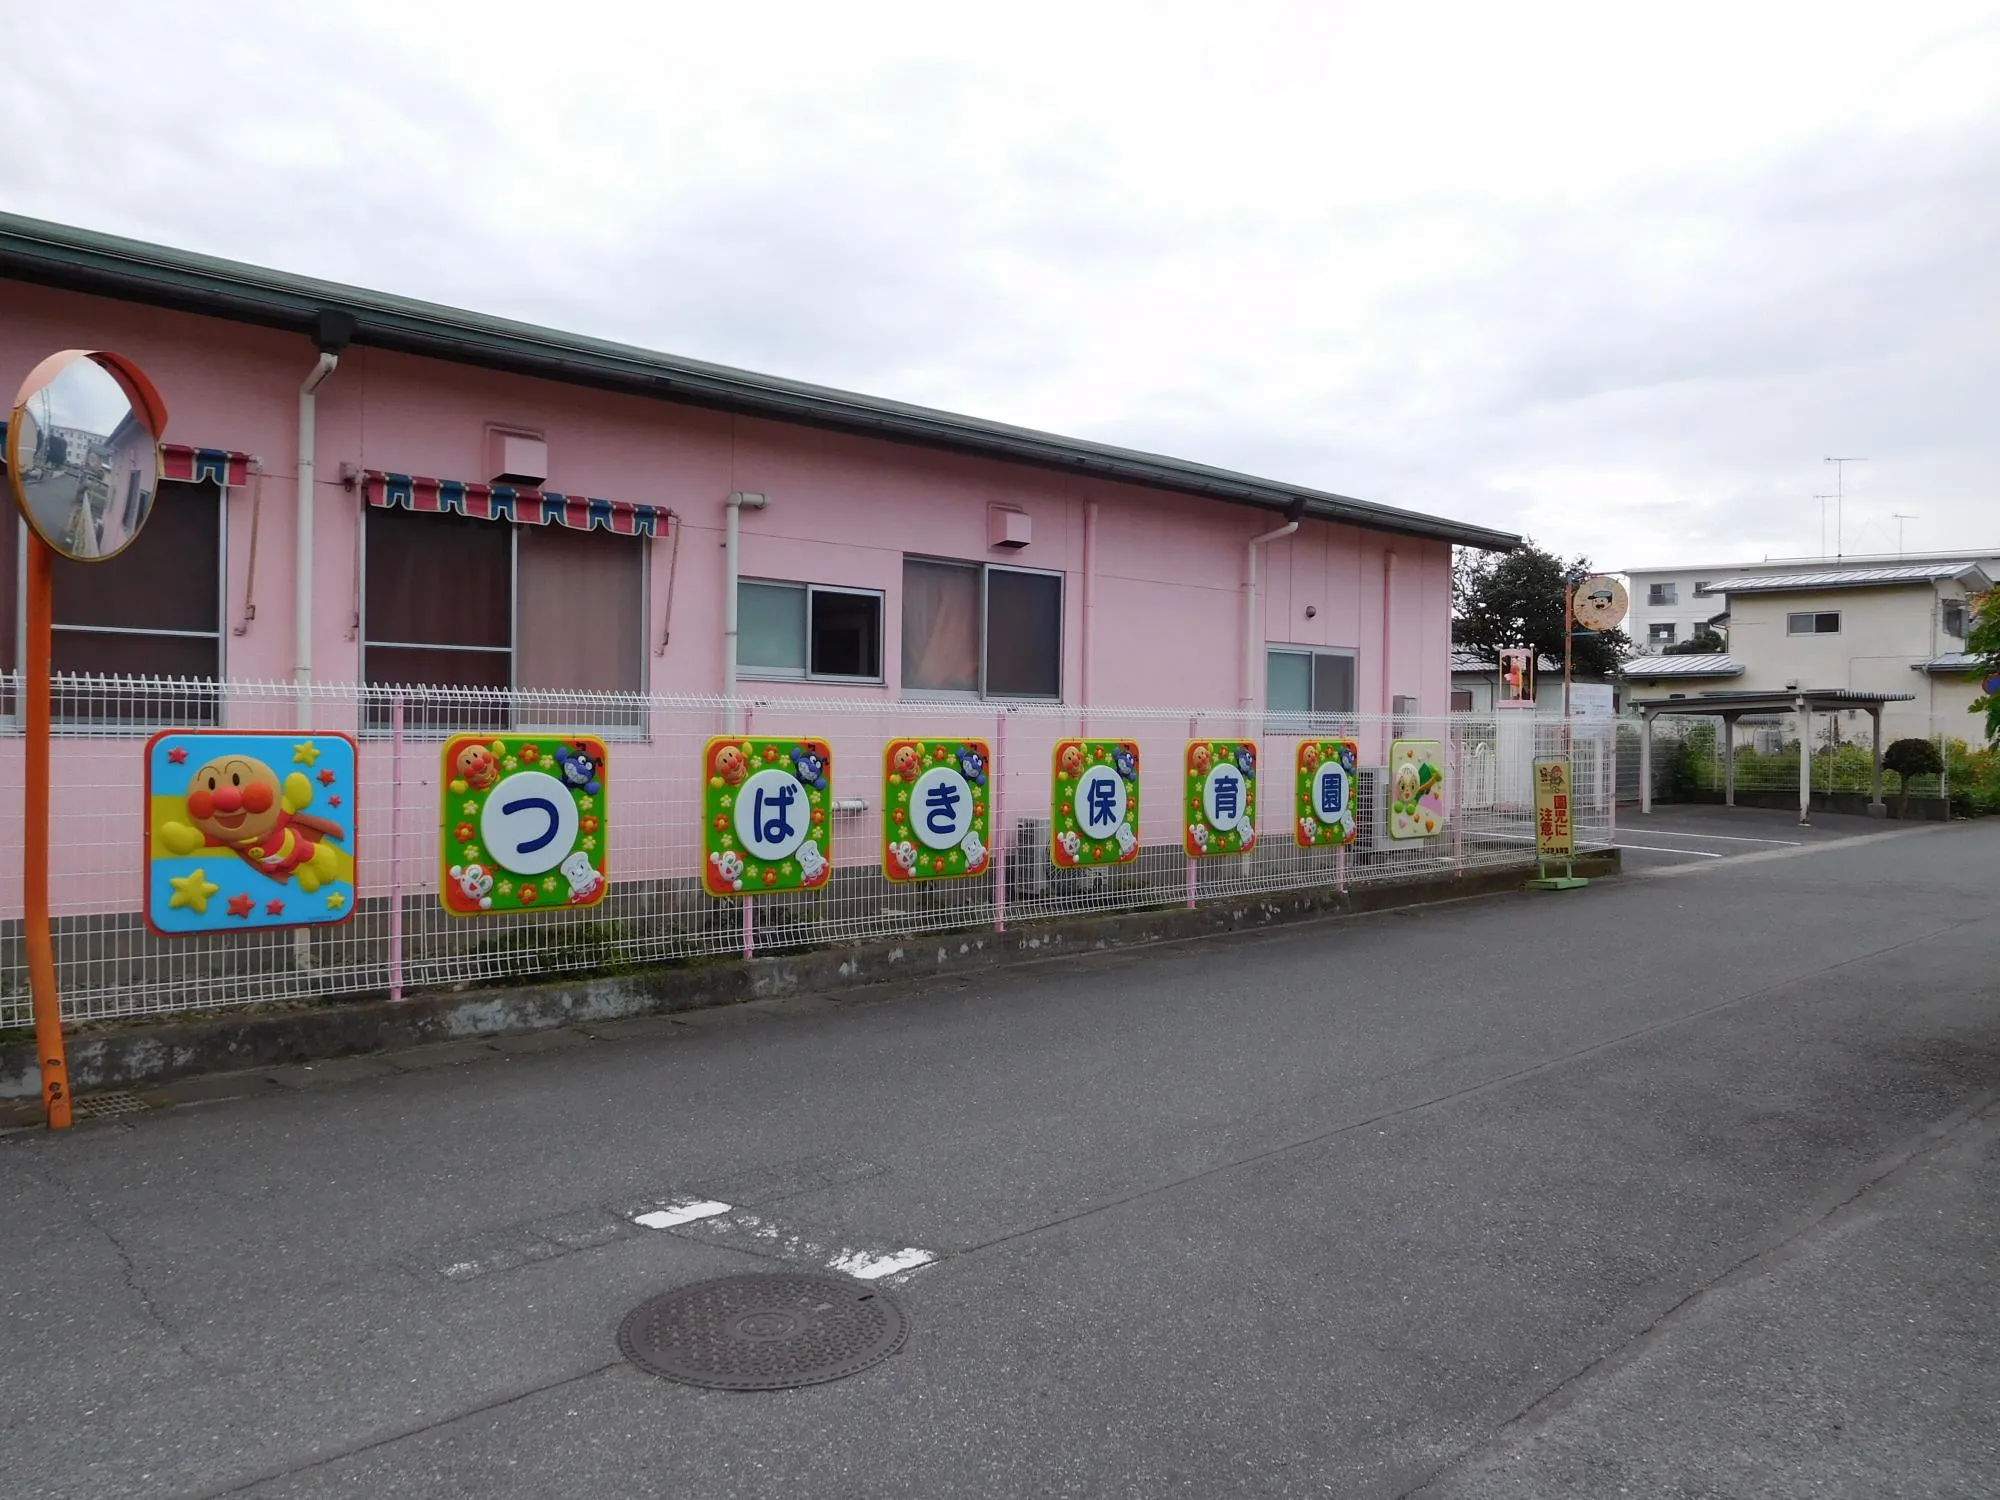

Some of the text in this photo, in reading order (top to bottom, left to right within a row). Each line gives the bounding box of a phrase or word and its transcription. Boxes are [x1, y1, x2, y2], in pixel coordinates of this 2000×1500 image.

[502, 773, 1342, 854] つ ば き 保 育 園
[1554, 795, 1568, 836] 園児に
